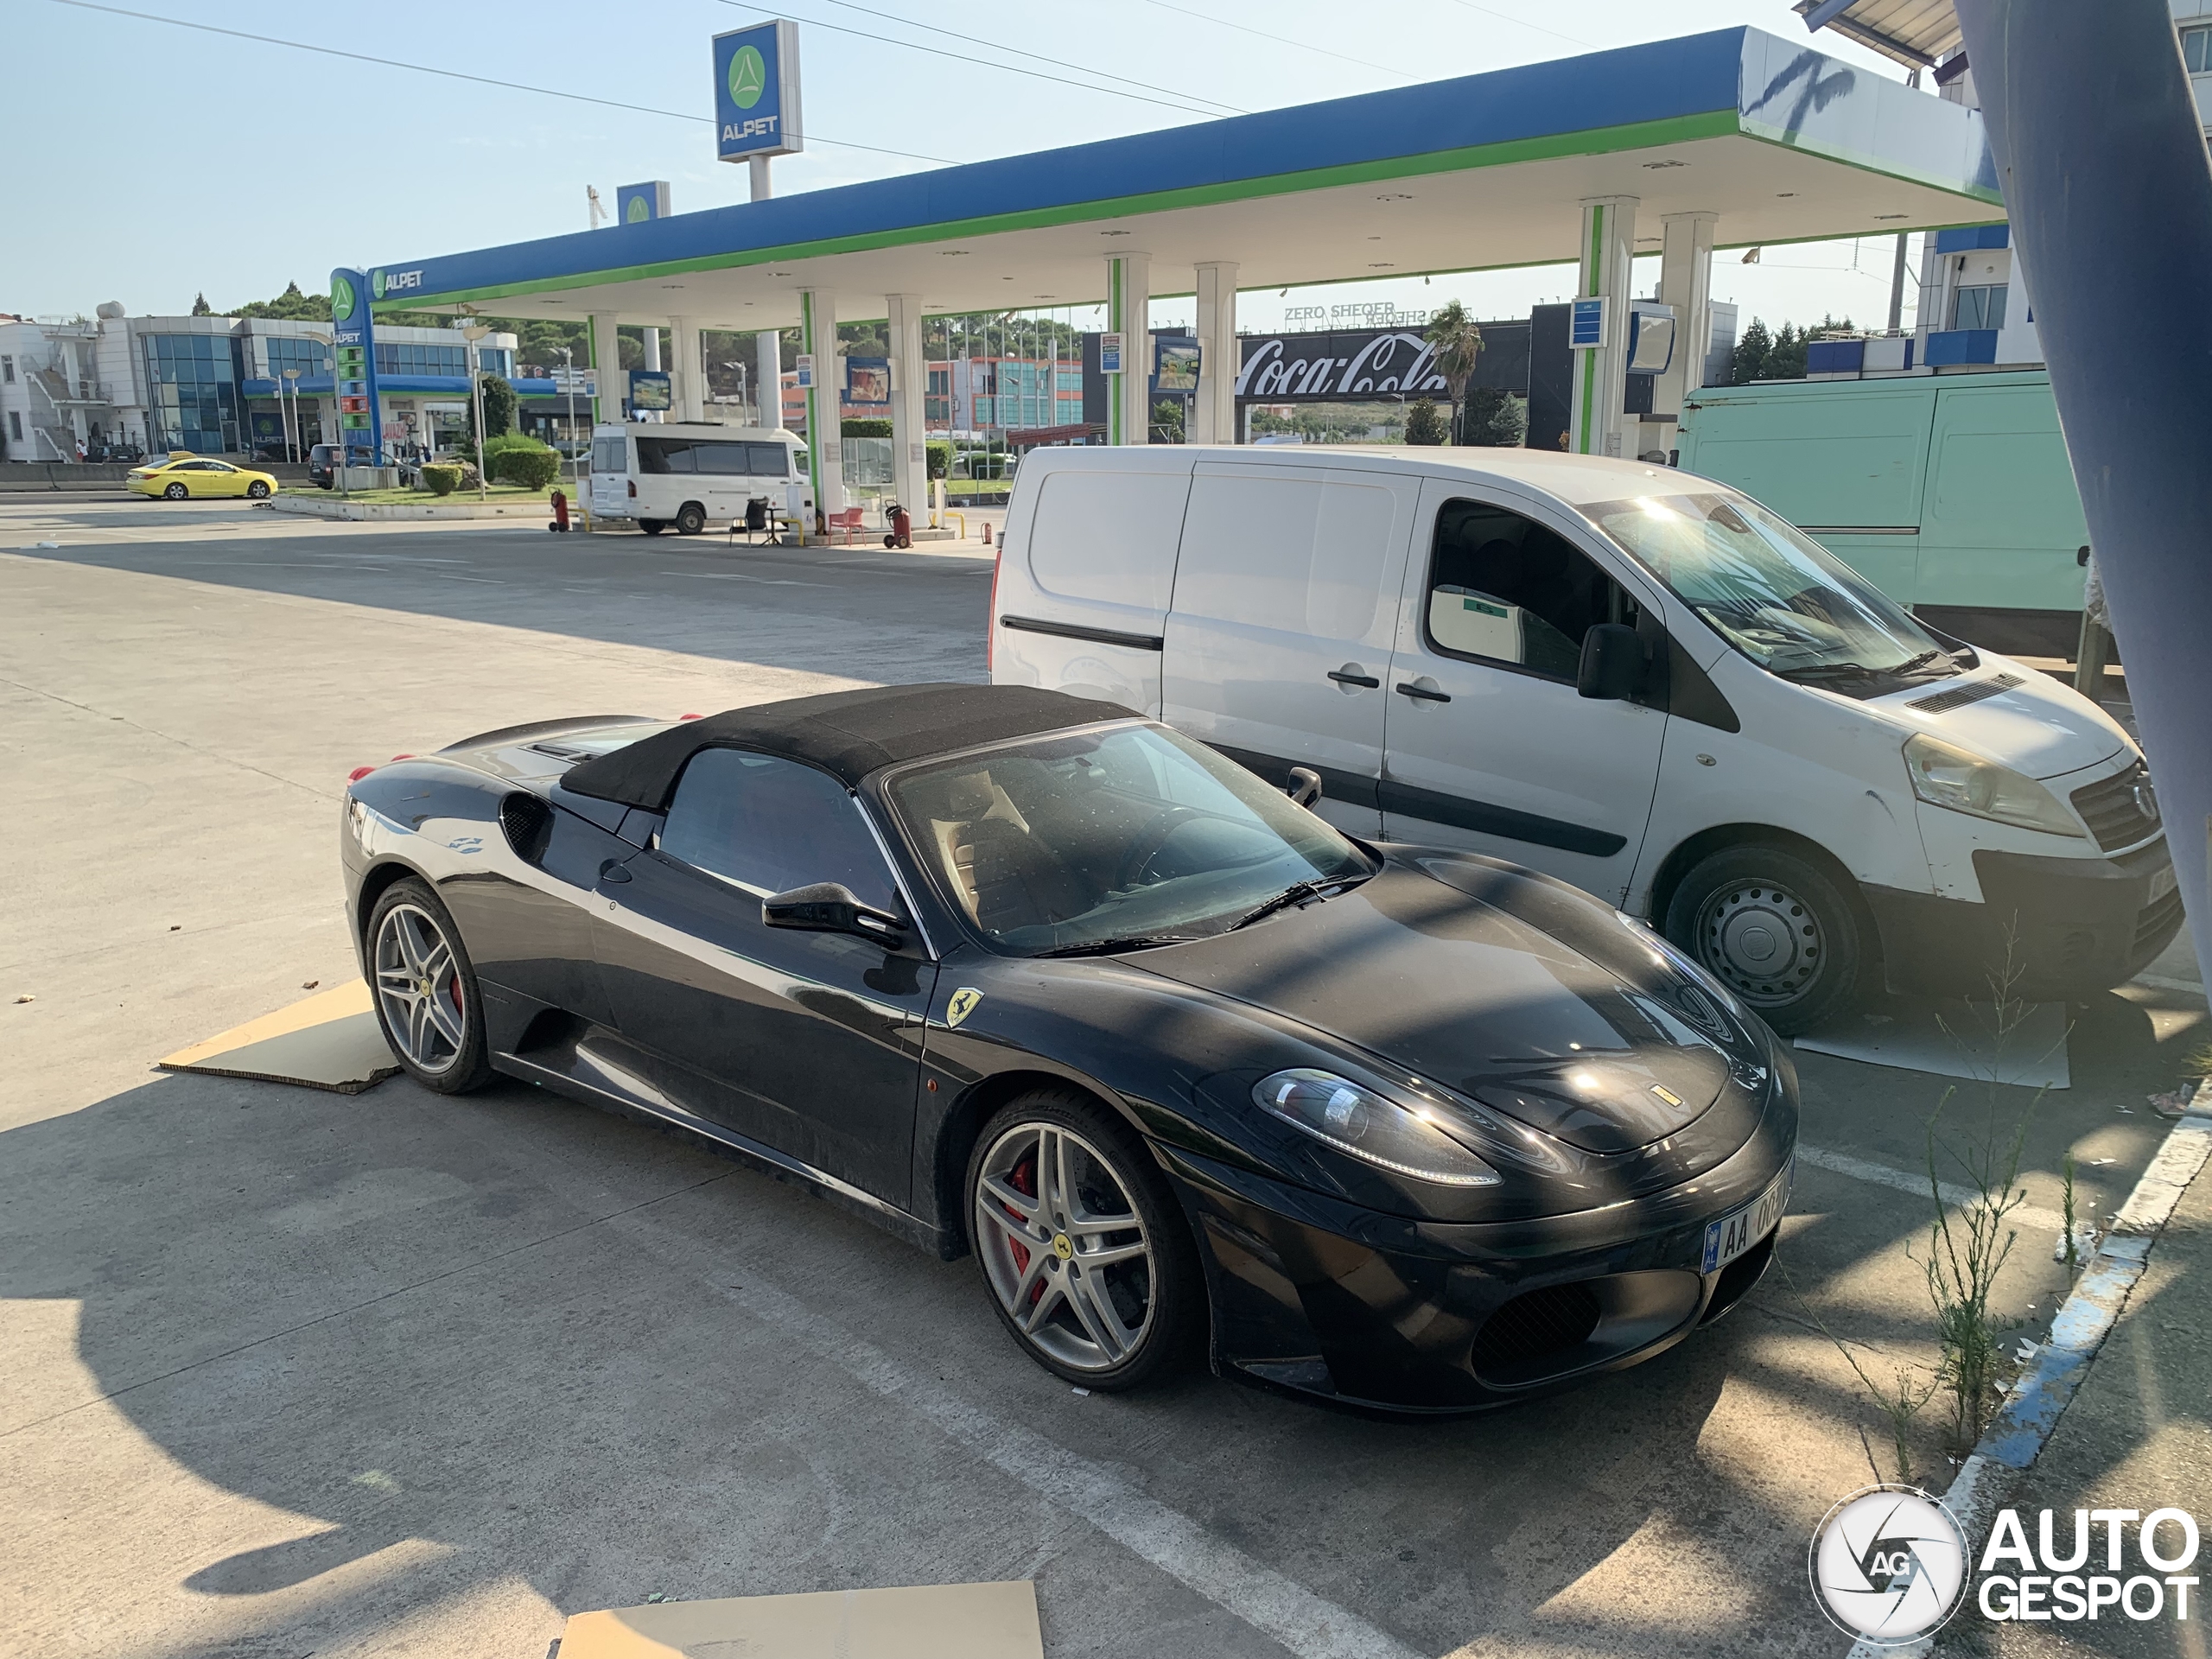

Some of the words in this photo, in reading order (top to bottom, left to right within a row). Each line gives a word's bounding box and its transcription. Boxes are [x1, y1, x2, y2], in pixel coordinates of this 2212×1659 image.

[721, 115, 778, 142] ALPET
[385, 270, 423, 290] ALPET
[1285, 306, 1325, 321] ZERO
[1331, 302, 1395, 317] SHEQER
[1723, 1213, 1748, 1258] AA
[1706, 1254, 1715, 1266] AL
